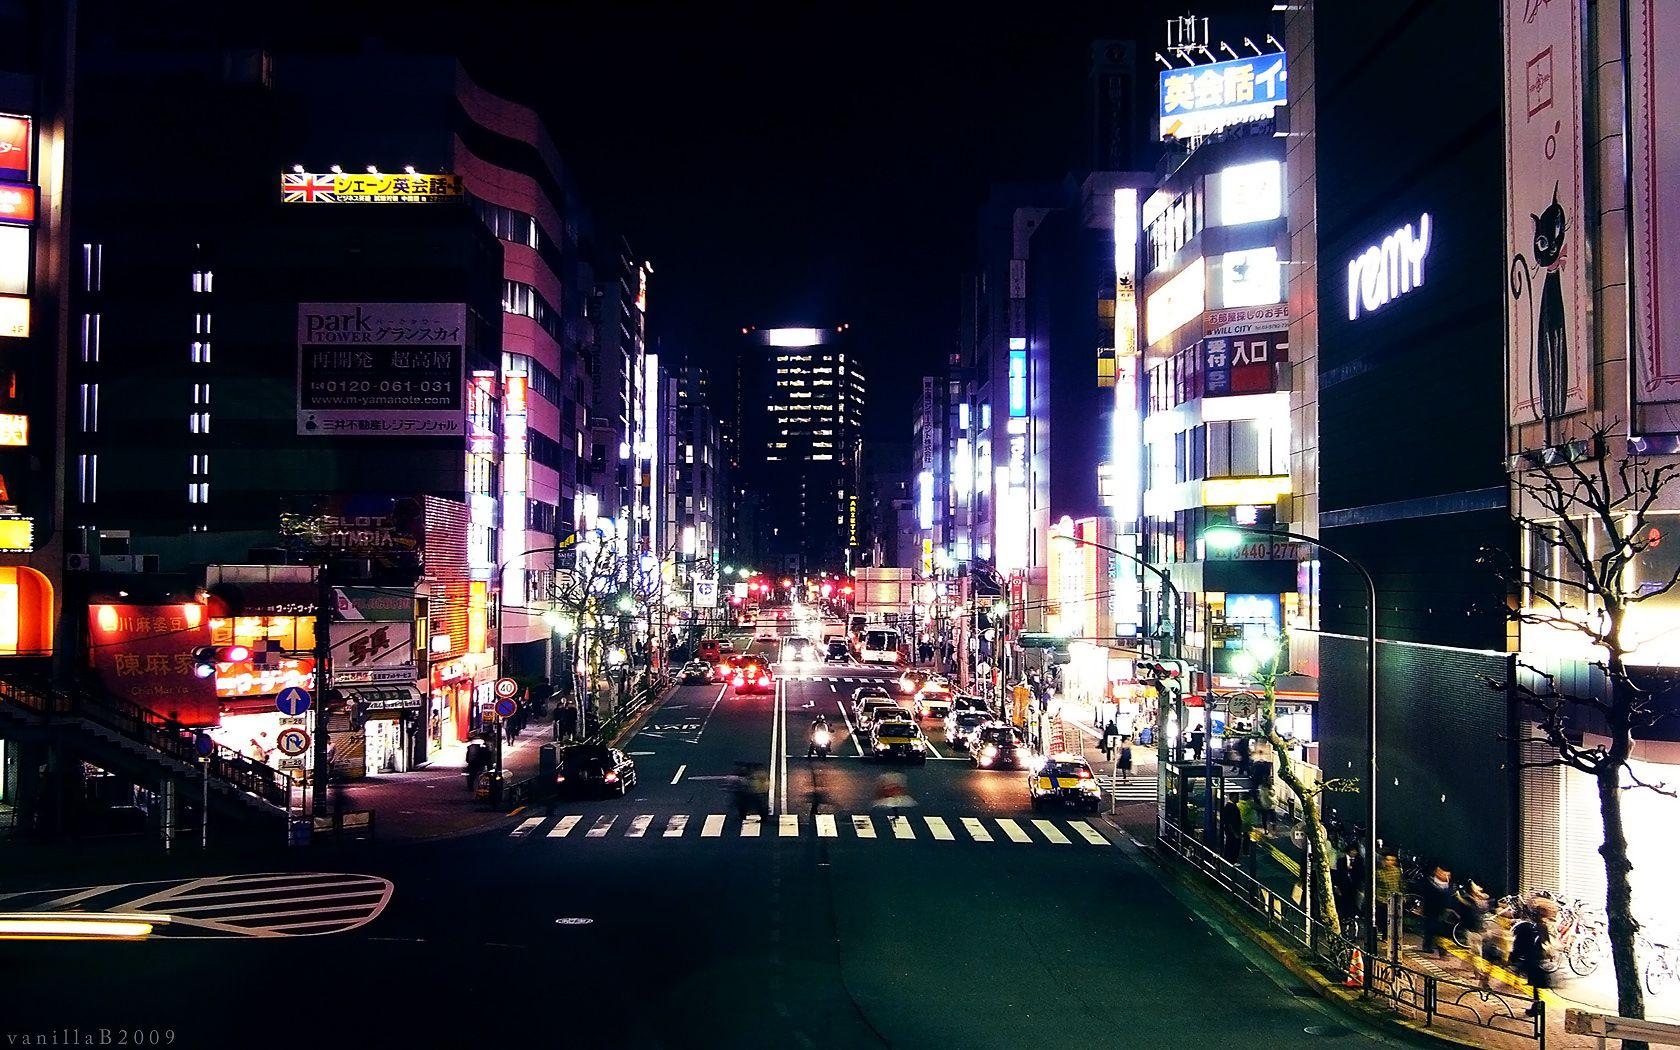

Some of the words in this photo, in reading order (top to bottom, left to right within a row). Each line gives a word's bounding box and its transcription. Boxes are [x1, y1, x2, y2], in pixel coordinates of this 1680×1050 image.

[1164, 58, 1287, 113] 英会話イ
[1348, 212, 1432, 321] remy
[304, 306, 372, 342] park
[1214, 327, 1232, 335] WILL
[1234, 324, 1252, 333] CITY
[314, 331, 371, 342] TOWER
[374, 327, 460, 342] グランスカイ
[391, 351, 451, 368] 超高層
[1231, 341, 1267, 366] 入口
[326, 381, 451, 392] 0120-061-031
[311, 396, 451, 405] www.m-yamanote.com
[323, 419, 458, 431] 三井不動産レジデンシャル
[1233, 543, 1298, 560] 3440-277
[103, 616, 201, 633] 川麻婆豆
[349, 625, 390, 666] 写真
[114, 652, 192, 677] 陳麻家
[500, 684, 513, 693] 40
